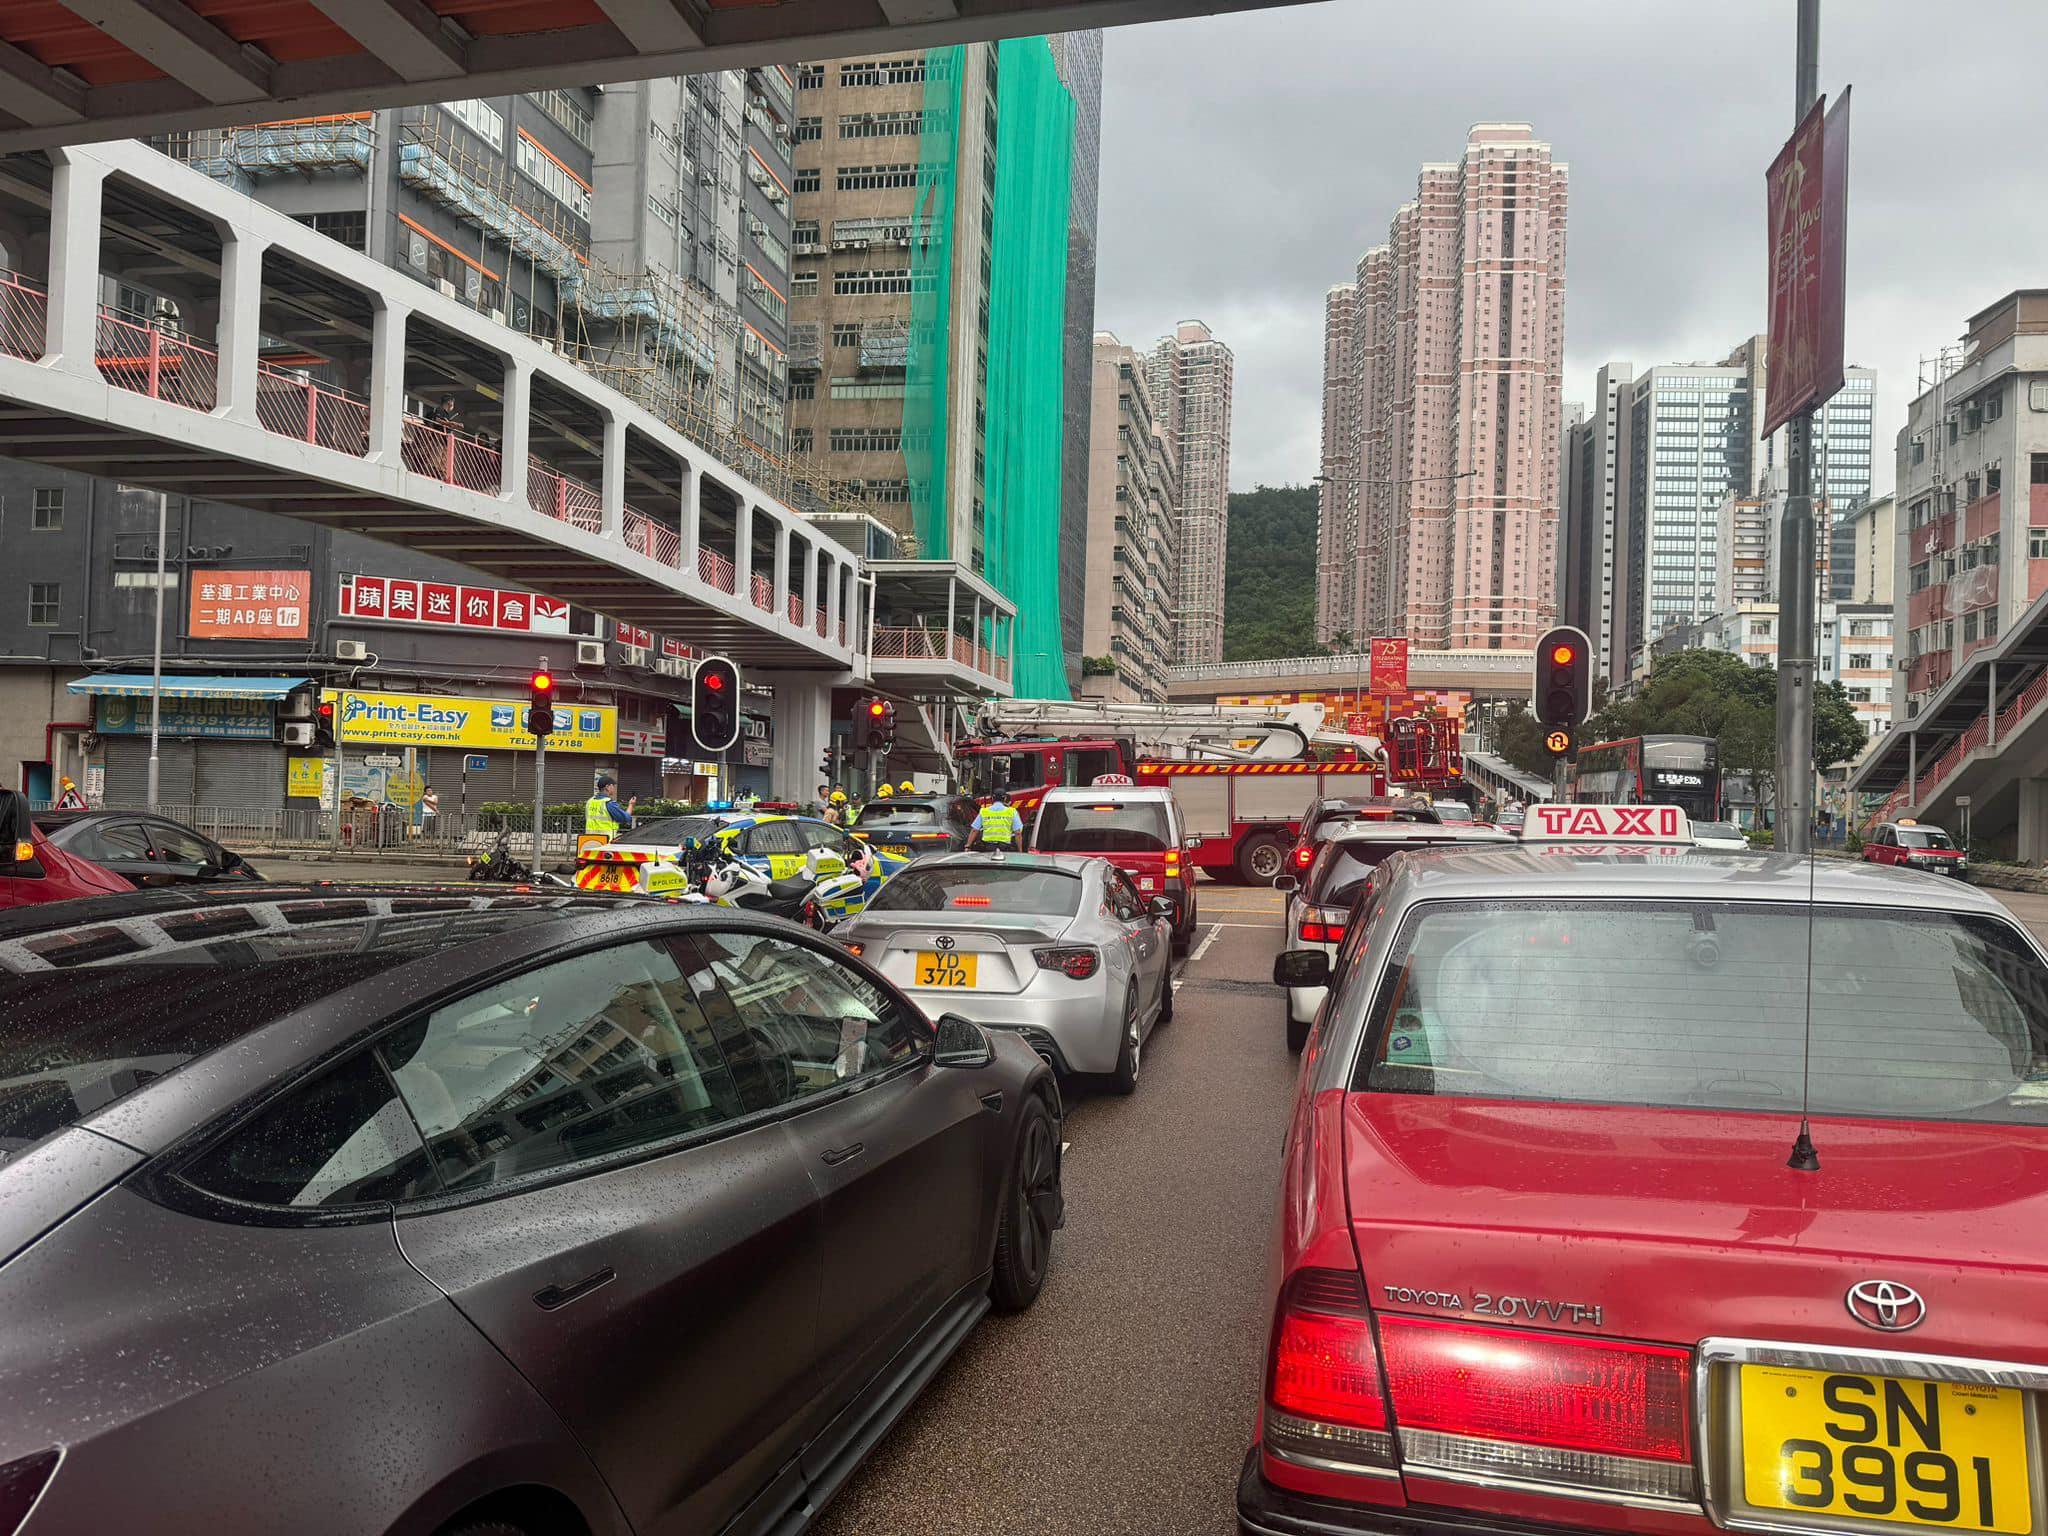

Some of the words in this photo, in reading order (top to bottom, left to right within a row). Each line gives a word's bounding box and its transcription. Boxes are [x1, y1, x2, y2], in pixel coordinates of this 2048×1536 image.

[358, 585, 524, 622] 蘋果迷你倉
[1381, 640, 1399, 656] 75
[351, 699, 469, 729] Print-Easy
[343, 728, 461, 741] www.print-easy.com.hk
[558, 739, 583, 748] 7188
[1097, 775, 1128, 785] TAXI
[1538, 807, 1678, 836] TAXI
[600, 873, 619, 883] 8618
[657, 878, 678, 887] POLICE
[934, 952, 959, 968] YD
[923, 968, 967, 986] 3712
[1384, 1285, 1463, 1310] TOYOTA
[1962, 1383, 1999, 1393] TOYOTA
[1822, 1375, 1942, 1451] SN
[1780, 1438, 1994, 1528] 3991
